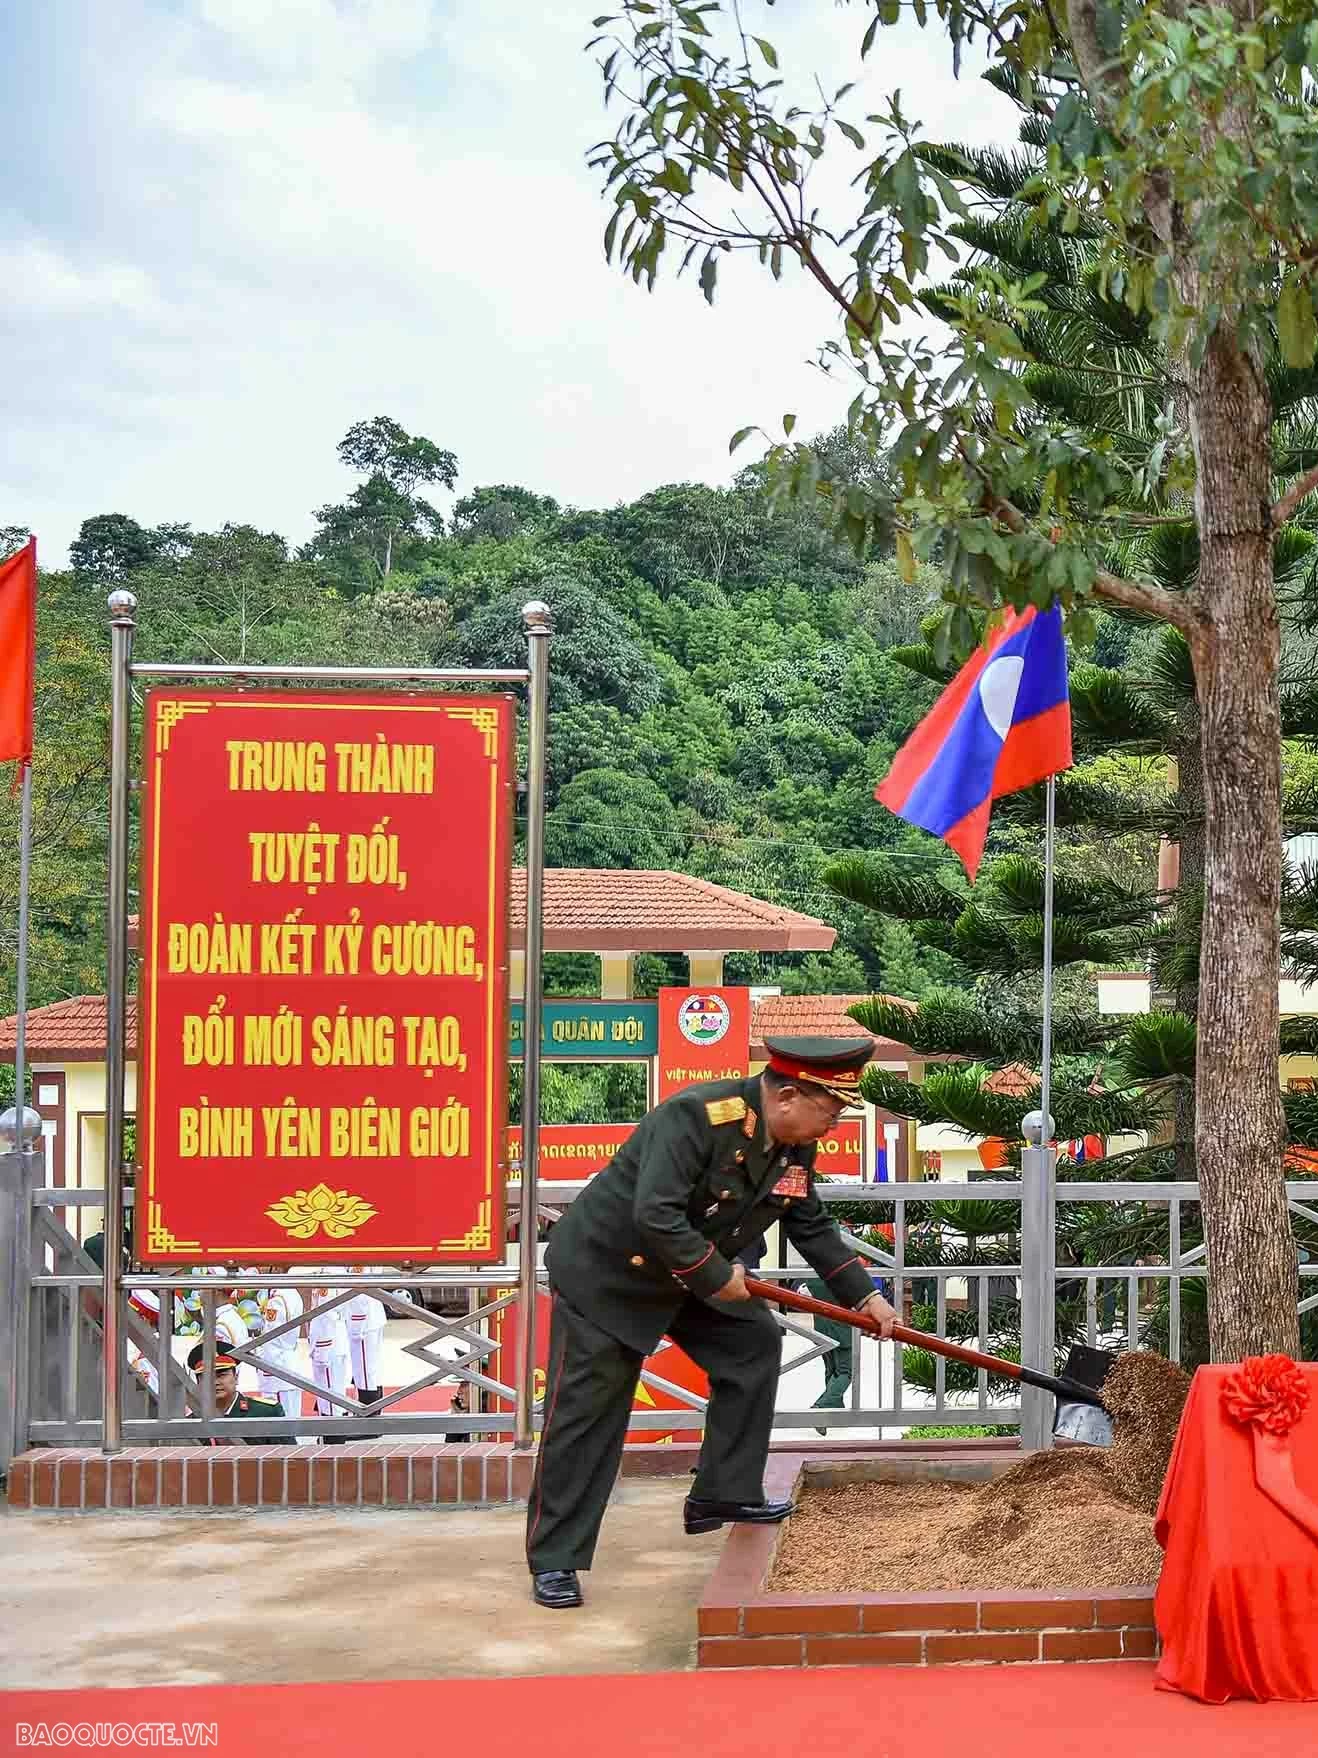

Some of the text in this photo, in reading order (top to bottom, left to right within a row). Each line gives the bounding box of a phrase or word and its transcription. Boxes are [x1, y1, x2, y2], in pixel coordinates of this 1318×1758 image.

[225, 733, 435, 794] TRUNG THÀNH
[249, 816, 407, 895] TUYỆT ĐỐI,
[167, 907, 484, 982] ĐOÀN KẾT KỶ CƯƠNG,
[182, 994, 467, 1078] ĐỔI MỚI SÁNG TẠO,
[552, 1015, 605, 1043] QUÂN
[611, 1015, 644, 1045] ĐỘI
[689, 1069, 712, 1081] NAM
[179, 1095, 470, 1158] BÌNH YÊN BIÊN GIỚI
